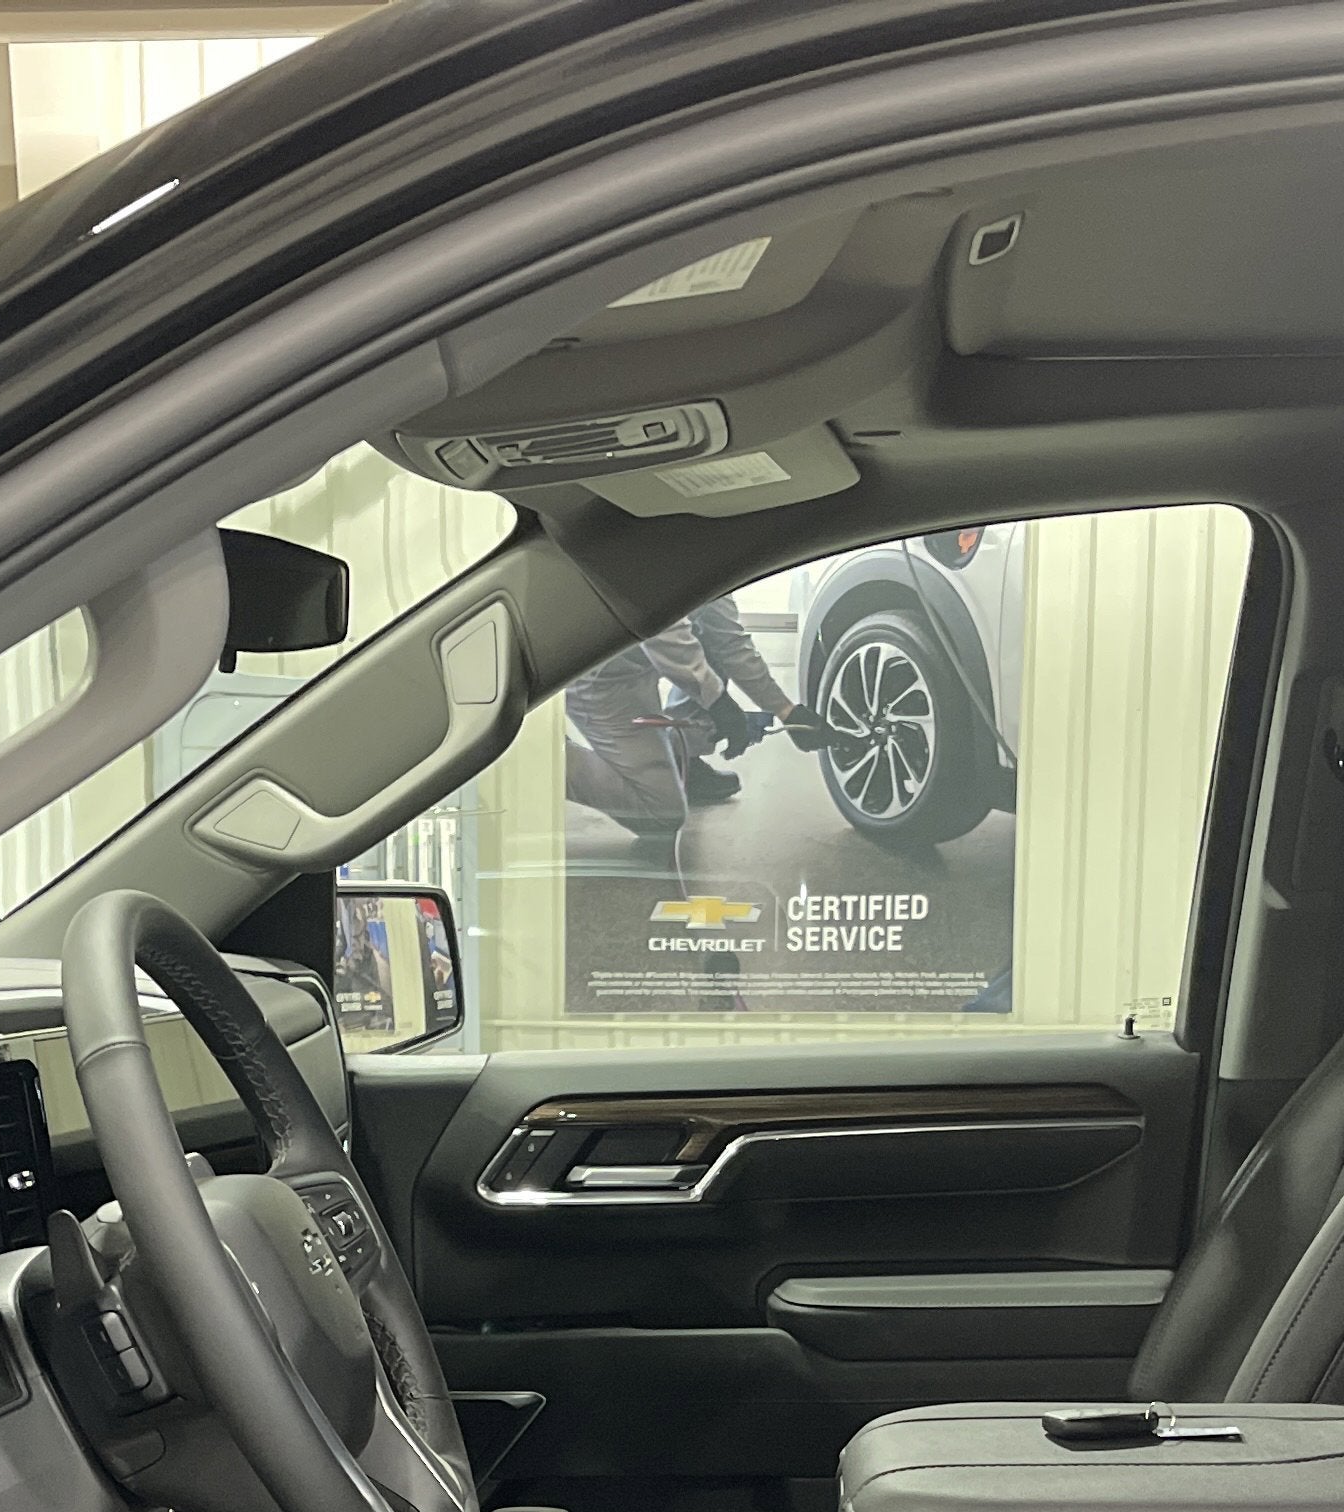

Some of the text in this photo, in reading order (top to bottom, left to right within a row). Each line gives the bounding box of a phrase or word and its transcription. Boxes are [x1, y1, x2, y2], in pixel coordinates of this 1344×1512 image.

[786, 894, 929, 922] CERTIFIED
[648, 937, 766, 952] CHEVROLET
[786, 925, 903, 952] SERVICE
